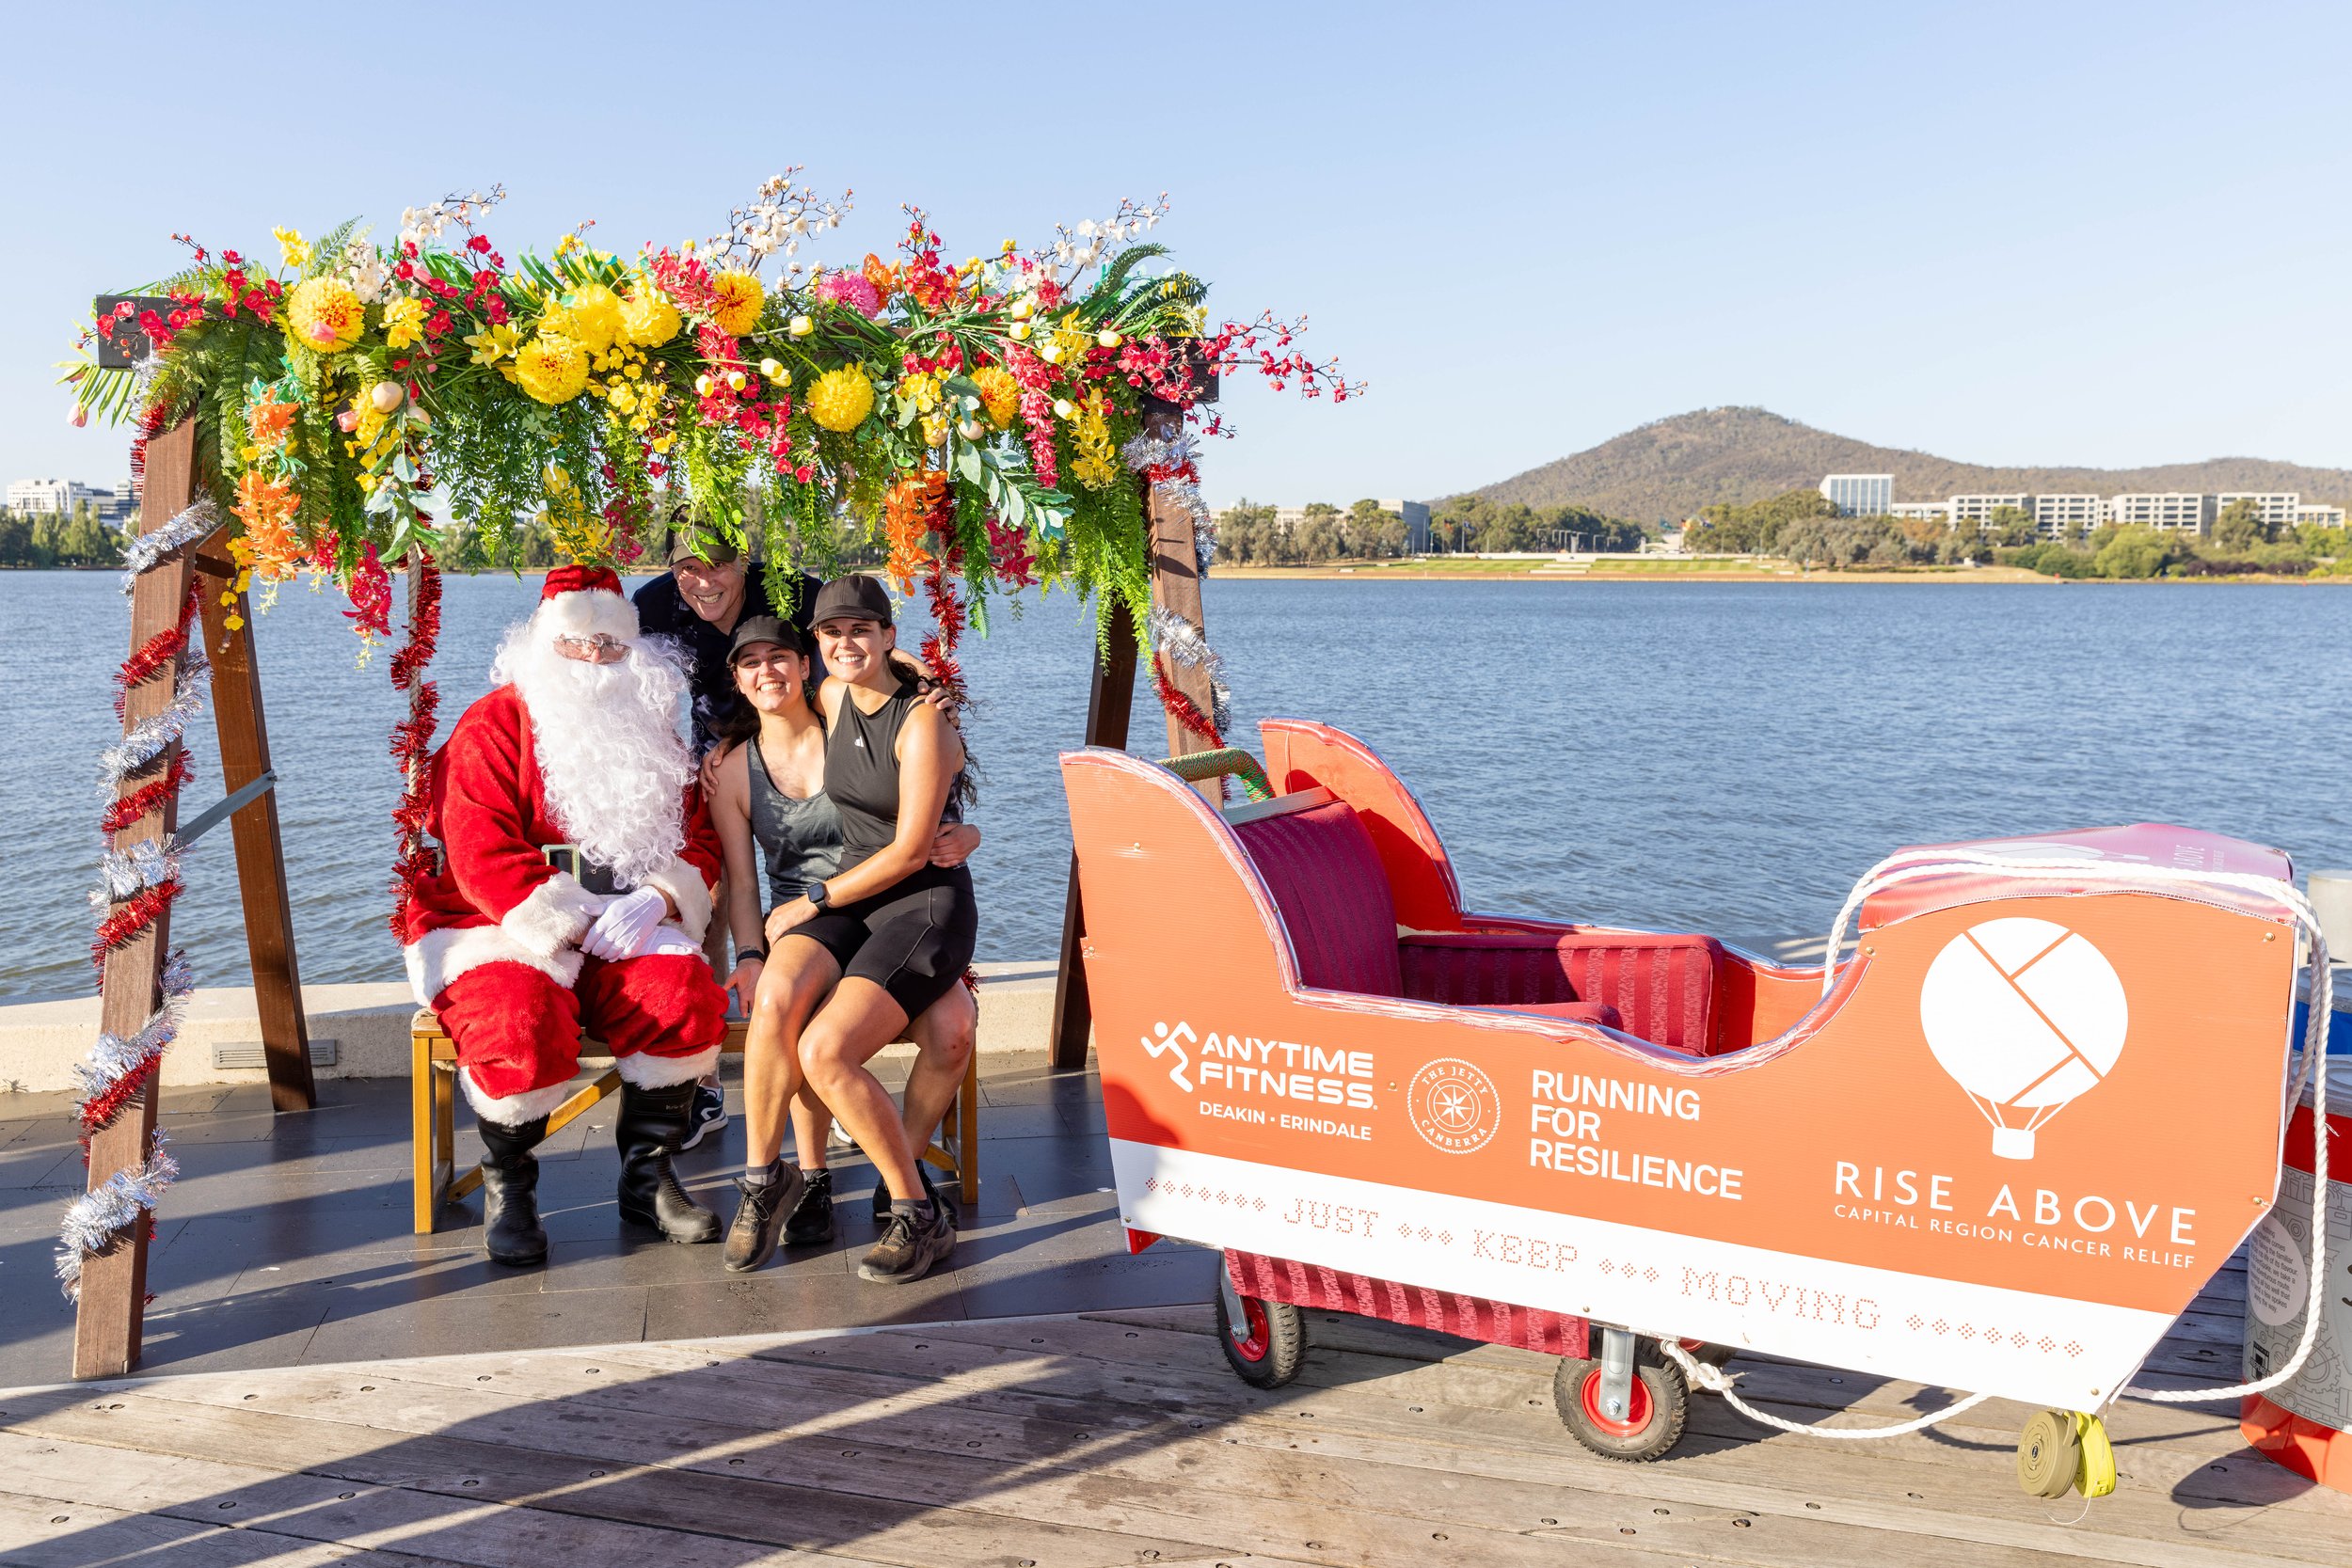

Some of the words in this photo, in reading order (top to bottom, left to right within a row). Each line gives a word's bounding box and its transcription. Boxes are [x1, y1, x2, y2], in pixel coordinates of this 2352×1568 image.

[1200, 1032, 1374, 1079] ANYTIME
[1422, 1067, 1446, 1085] THE
[1451, 1066, 1488, 1095] JETTY
[1533, 1069, 1700, 1122] RUNNING
[1200, 1101, 1265, 1125] DEAKIN
[1280, 1115, 1372, 1141] ERINDALE
[1422, 1119, 1487, 1148] CANBERRA
[1532, 1104, 1601, 1142] FOR
[1531, 1139, 1743, 1200] RESILIENCE
[1836, 1161, 1953, 1212] RISE
[1987, 1184, 2196, 1246] ABOVE
[1835, 1205, 1918, 1228] CAPITAL
[1931, 1219, 2012, 1243] REGION
[2023, 1232, 2110, 1258] CANCER
[2123, 1247, 2195, 1268] RELIEF
[1283, 1197, 1379, 1239] JUST
[1472, 1227, 1579, 1273] KEEP
[1680, 1265, 1881, 1330] MOVING
